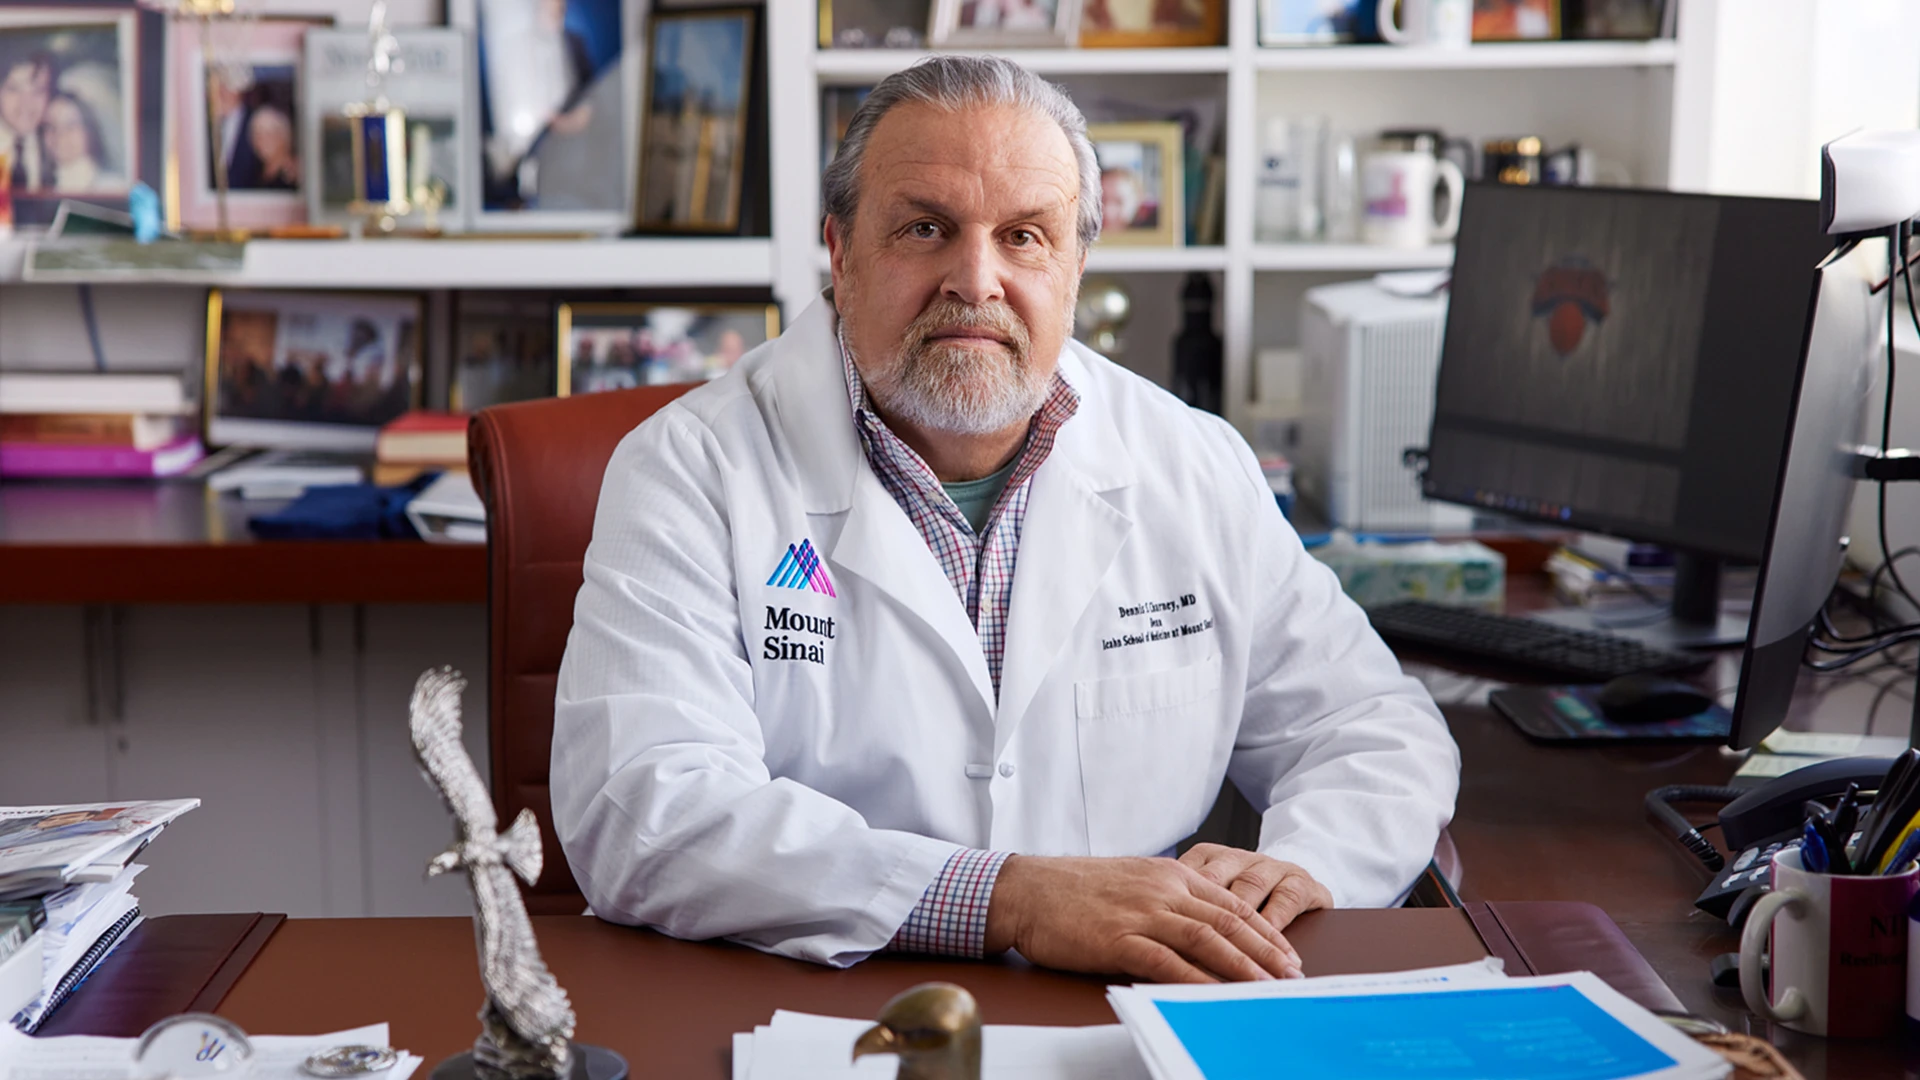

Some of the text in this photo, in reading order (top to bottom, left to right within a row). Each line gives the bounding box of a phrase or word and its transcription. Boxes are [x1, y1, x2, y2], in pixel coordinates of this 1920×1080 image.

[1118, 603, 1145, 618] Dennis
[1180, 593, 1197, 607] MD
[764, 605, 836, 640] Mount
[1102, 637, 1122, 651] Icahn
[1122, 632, 1144, 646] School
[1171, 627, 1180, 638] at
[1180, 622, 1203, 637] Mount
[763, 635, 825, 665] Sinai
